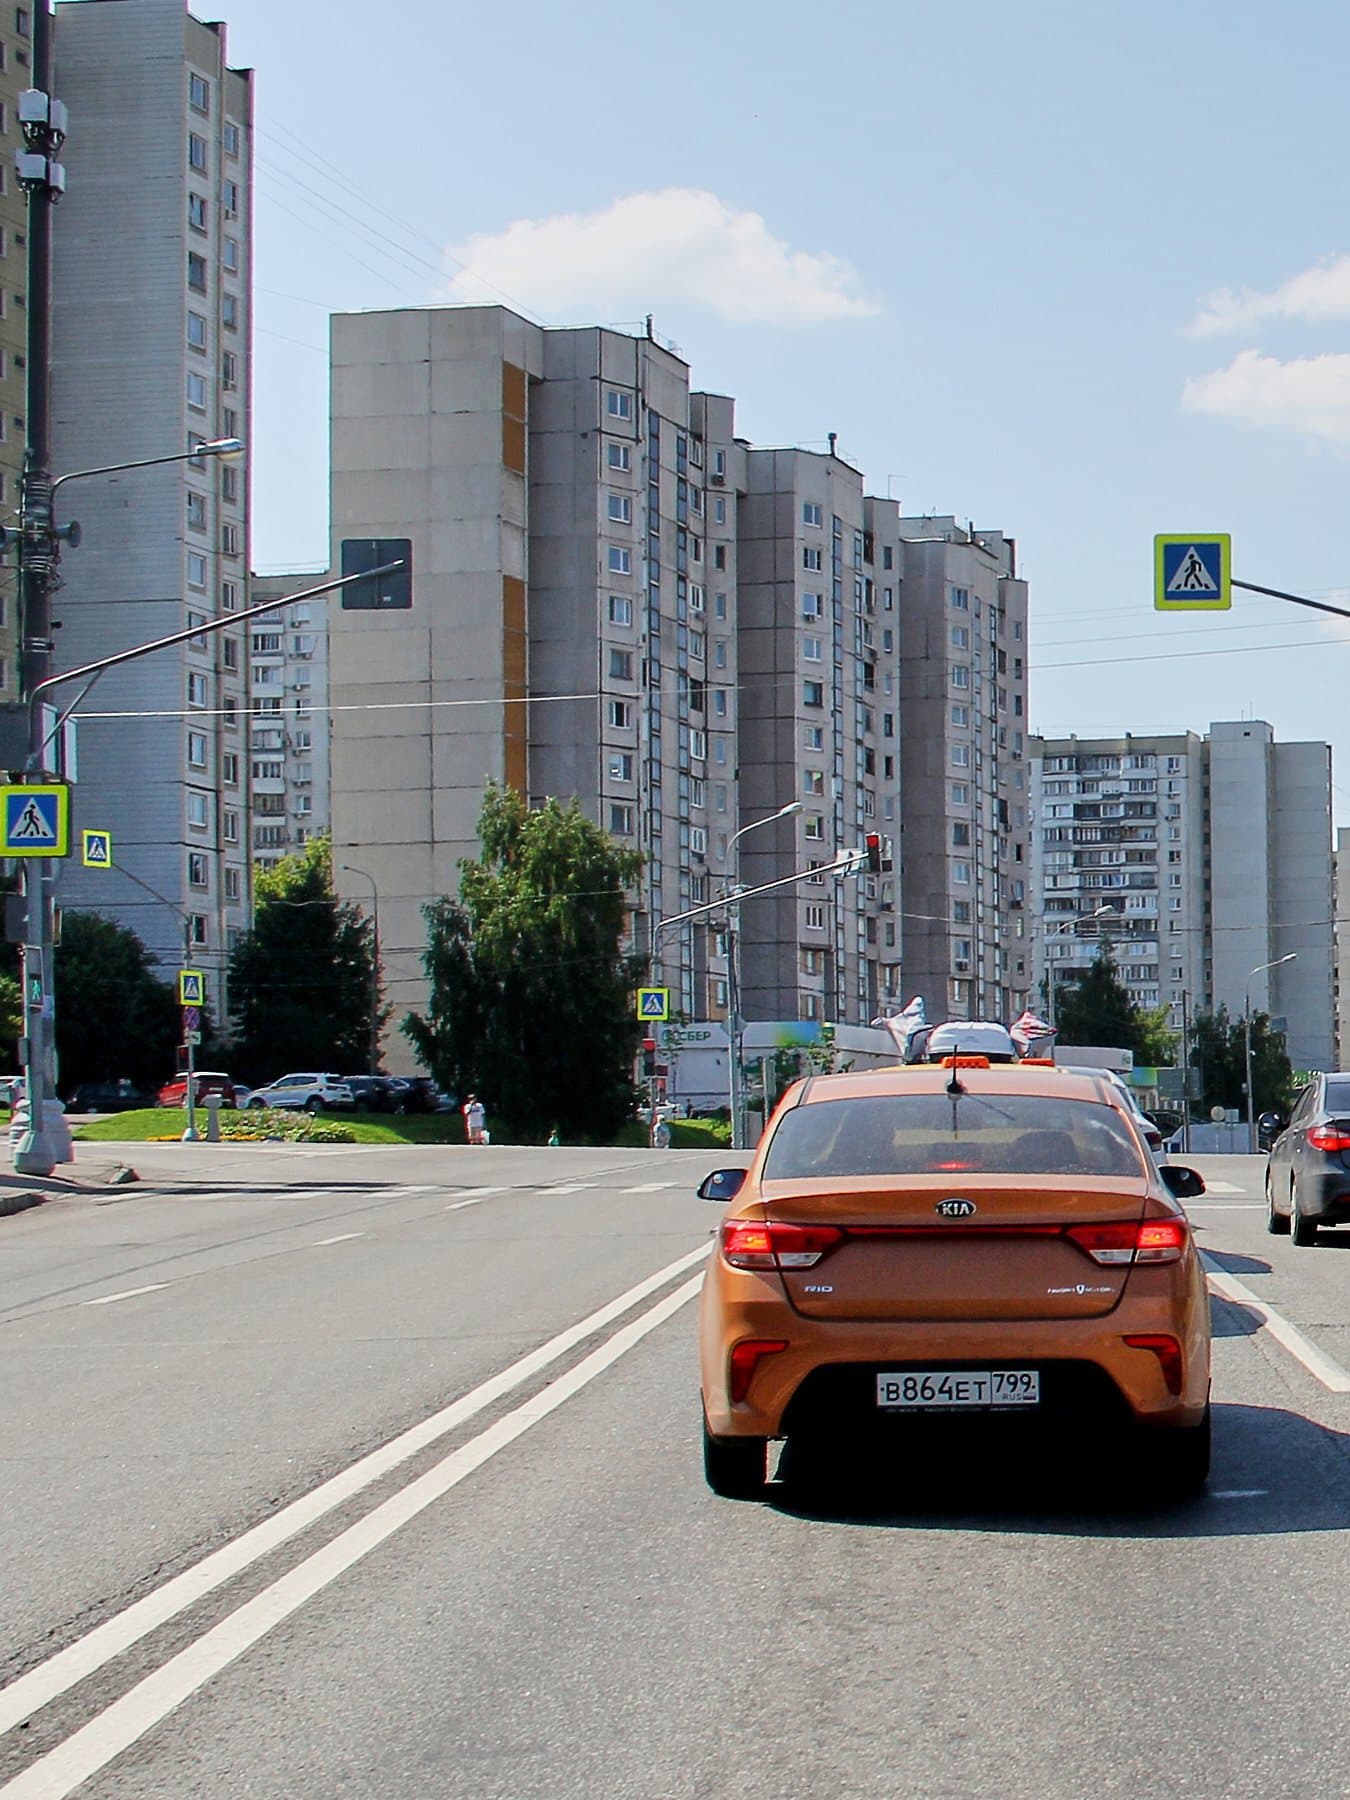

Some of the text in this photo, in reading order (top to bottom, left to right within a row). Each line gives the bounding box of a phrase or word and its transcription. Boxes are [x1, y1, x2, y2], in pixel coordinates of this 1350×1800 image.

[942, 1203, 970, 1215] KIA
[804, 1285, 833, 1293] RIO
[1002, 1393, 1021, 1401] RUS
